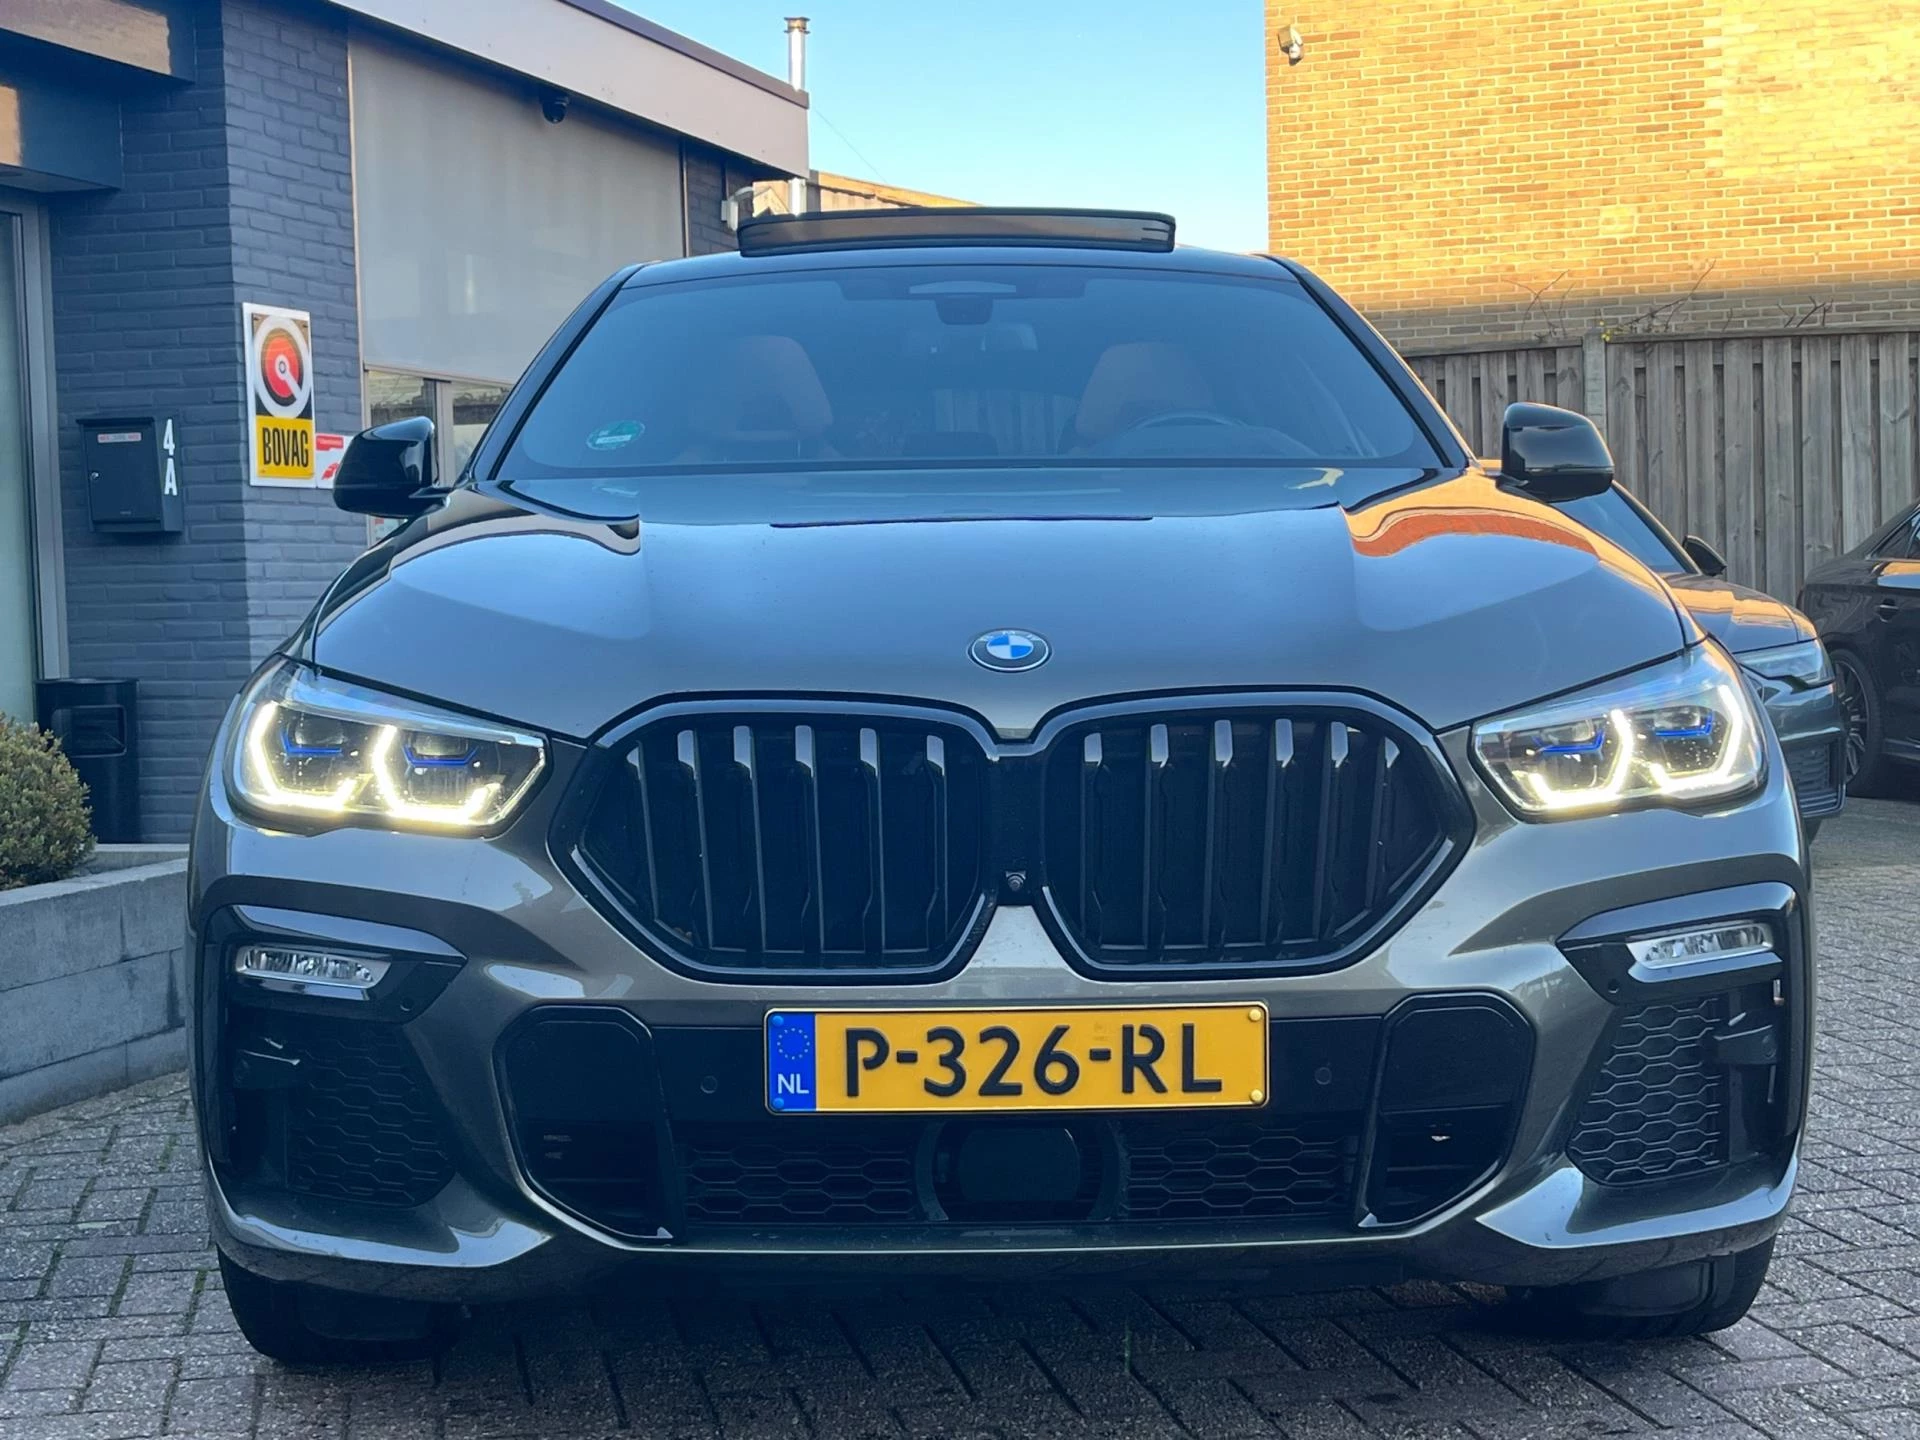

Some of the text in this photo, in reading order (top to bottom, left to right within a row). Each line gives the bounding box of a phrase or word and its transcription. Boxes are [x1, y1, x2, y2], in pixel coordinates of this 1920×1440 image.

[262, 427, 309, 467] BOVAG
[845, 1023, 1222, 1097] P-326-RL
[777, 1073, 810, 1094] NL
